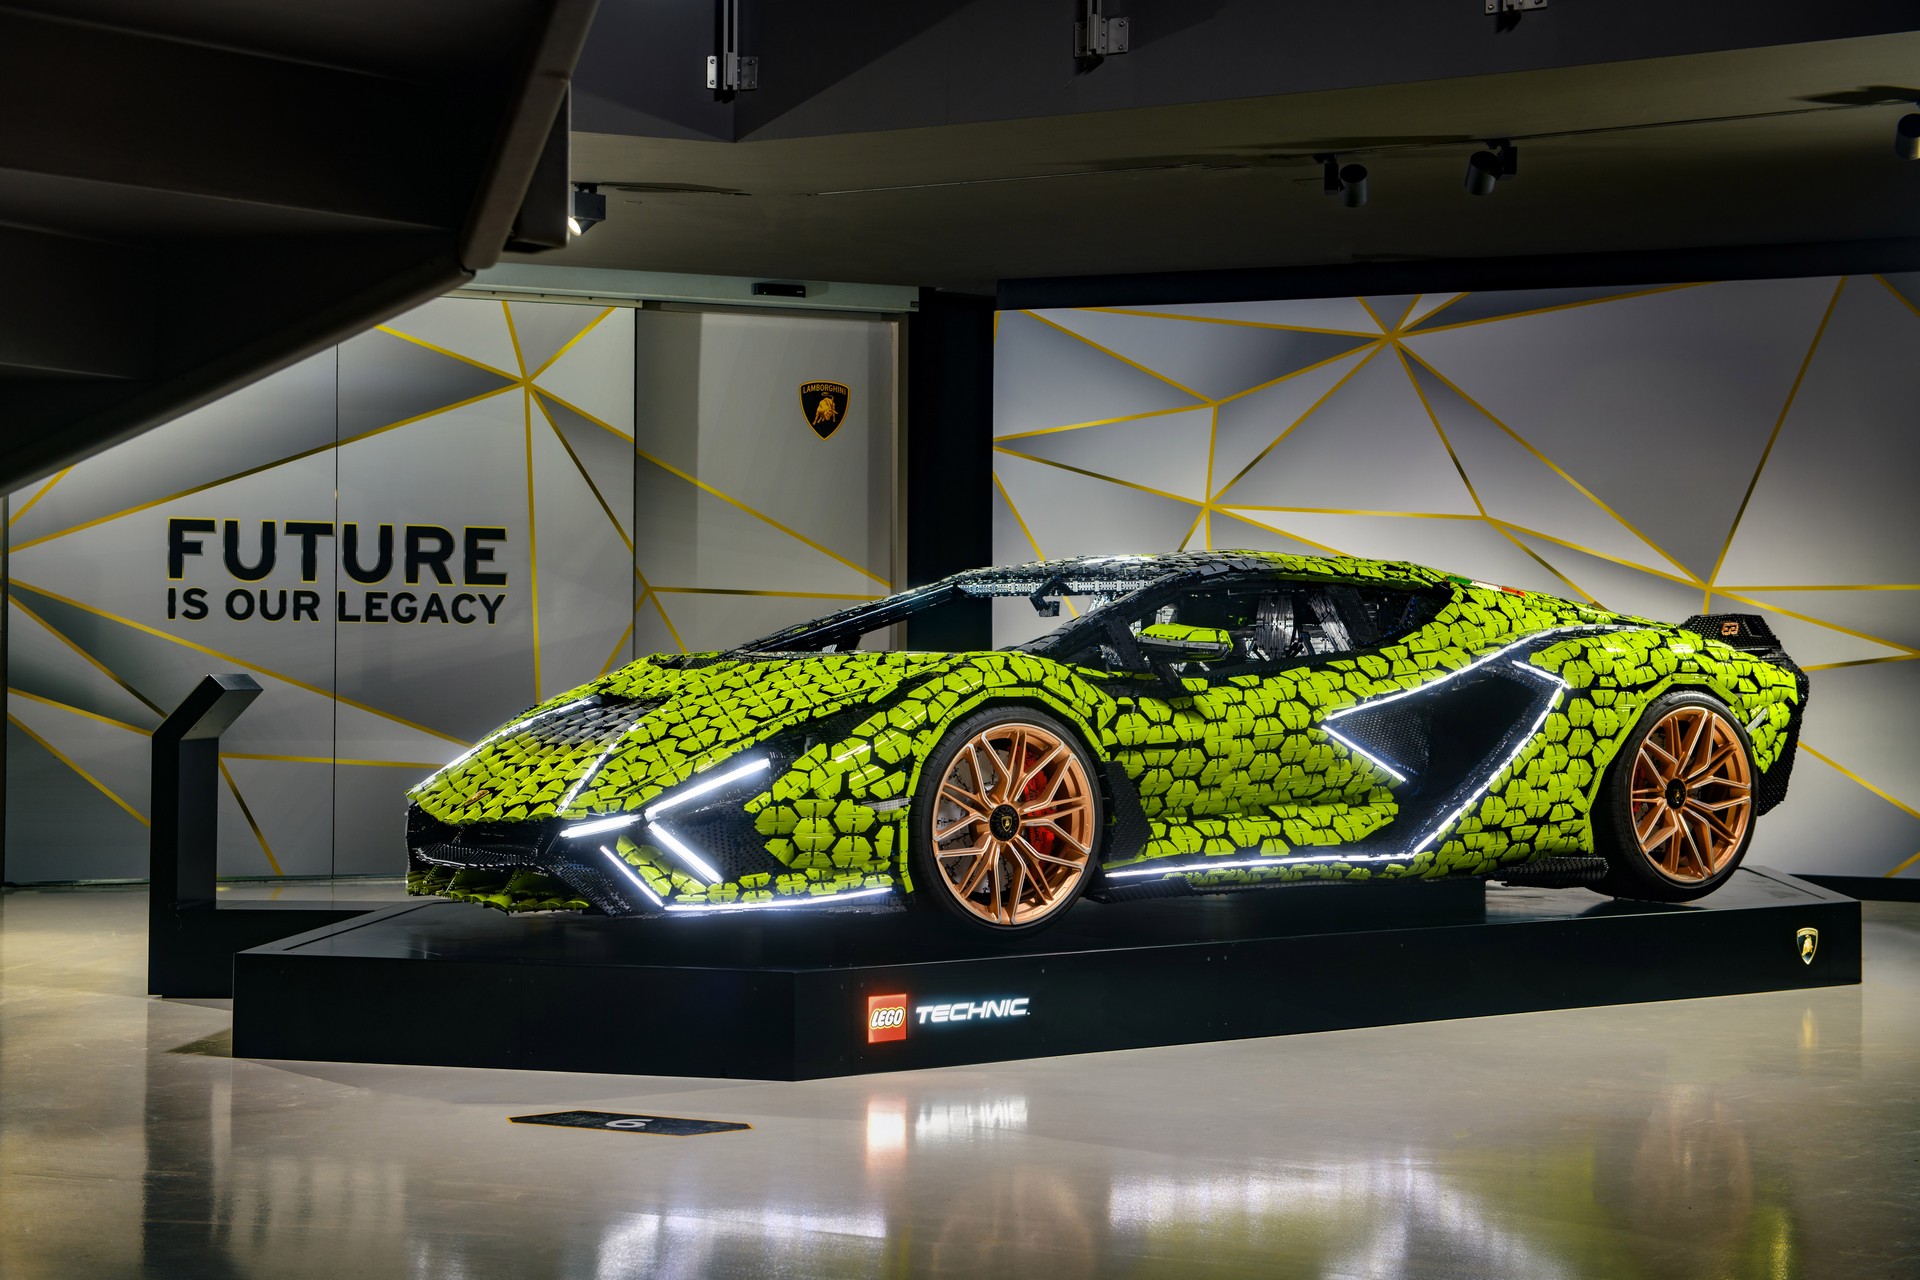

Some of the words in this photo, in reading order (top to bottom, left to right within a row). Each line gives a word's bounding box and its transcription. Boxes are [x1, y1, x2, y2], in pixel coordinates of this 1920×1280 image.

[802, 384, 847, 395] LAMBORGHINI
[167, 517, 507, 586] FUTURE
[167, 586, 209, 621] IS
[225, 588, 321, 622] OUR
[337, 590, 506, 625] LEGACY
[870, 1007, 905, 1029] LEGO
[605, 1118, 654, 1128] 6
